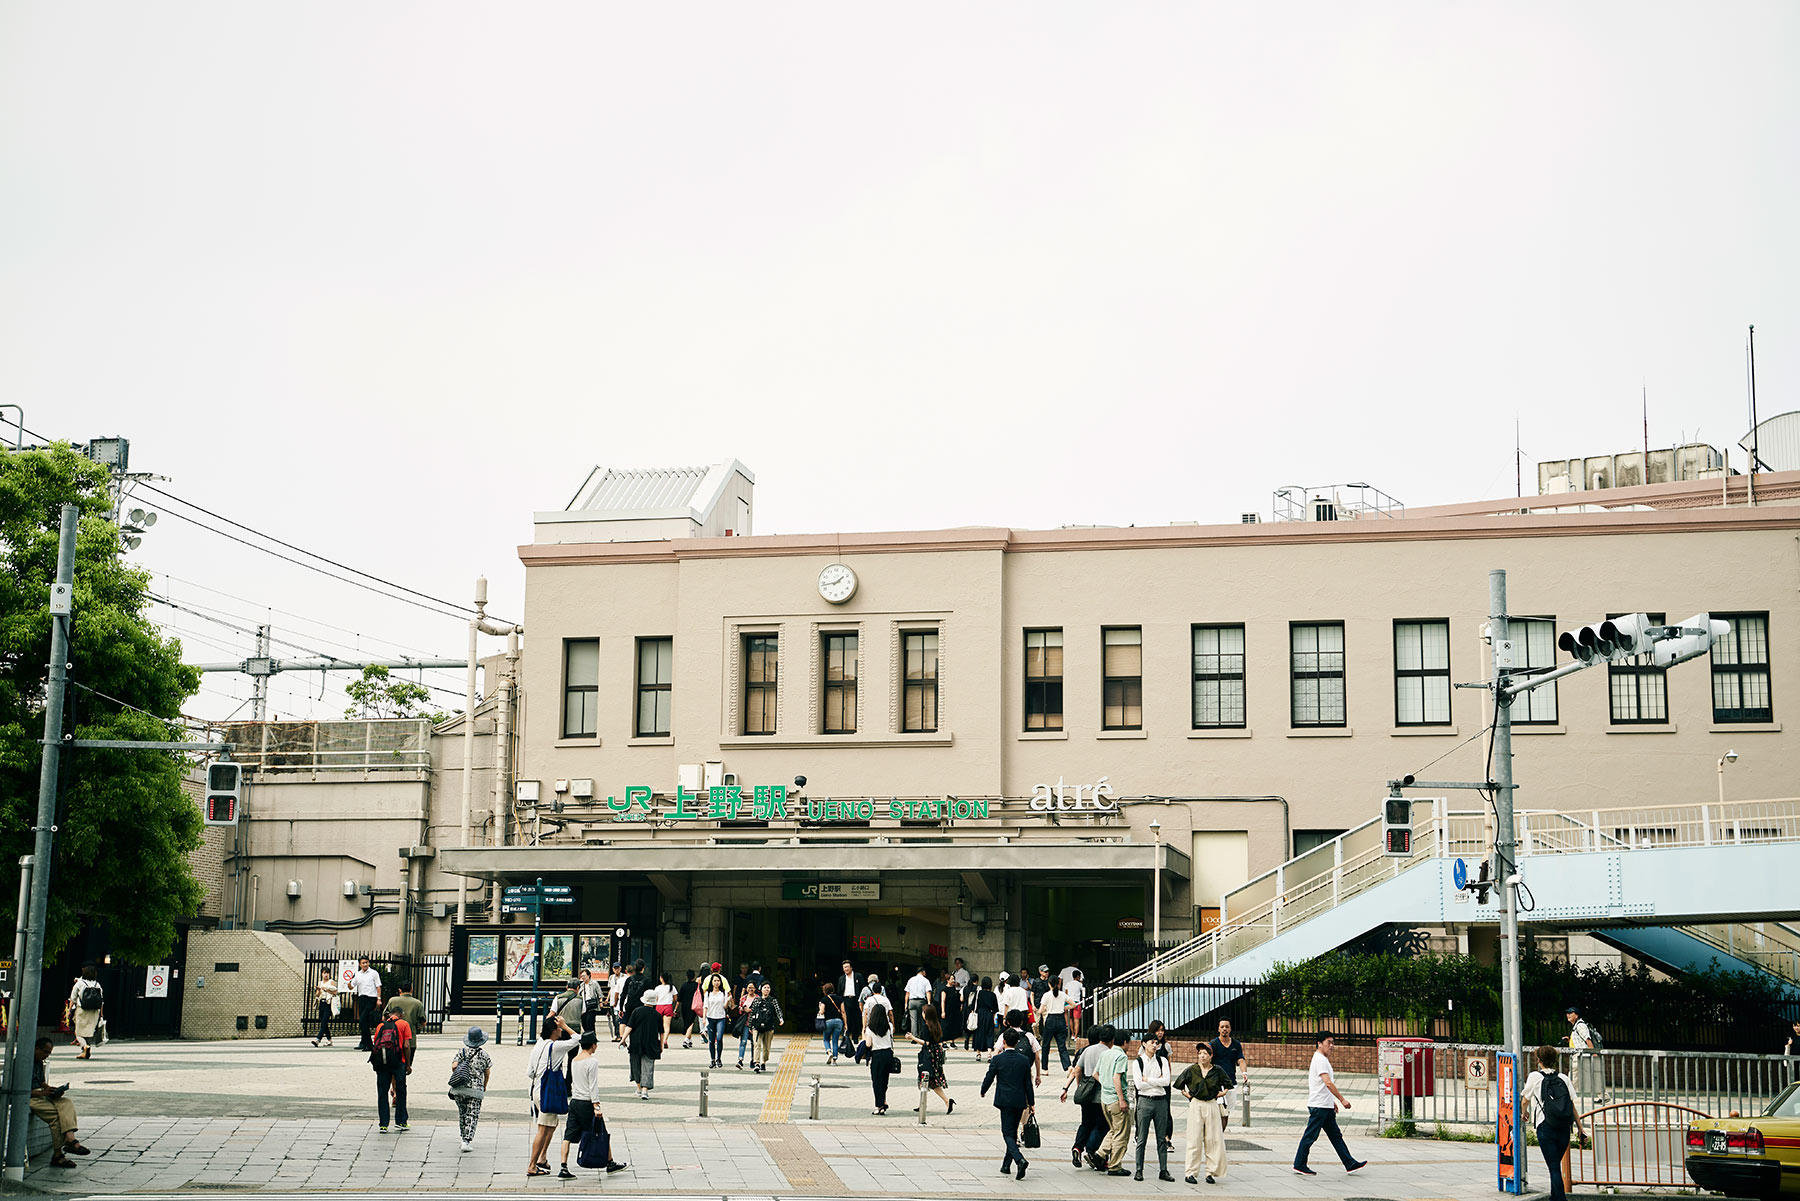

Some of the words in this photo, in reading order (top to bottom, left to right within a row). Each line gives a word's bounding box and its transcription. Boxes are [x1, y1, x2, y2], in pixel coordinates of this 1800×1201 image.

[607, 785, 652, 812] JR
[663, 784, 788, 820] 上野駅
[1030, 775, 1115, 811] atré
[808, 800, 875, 820] UENO
[889, 799, 989, 820] STATION
[802, 885, 817, 894] JR
